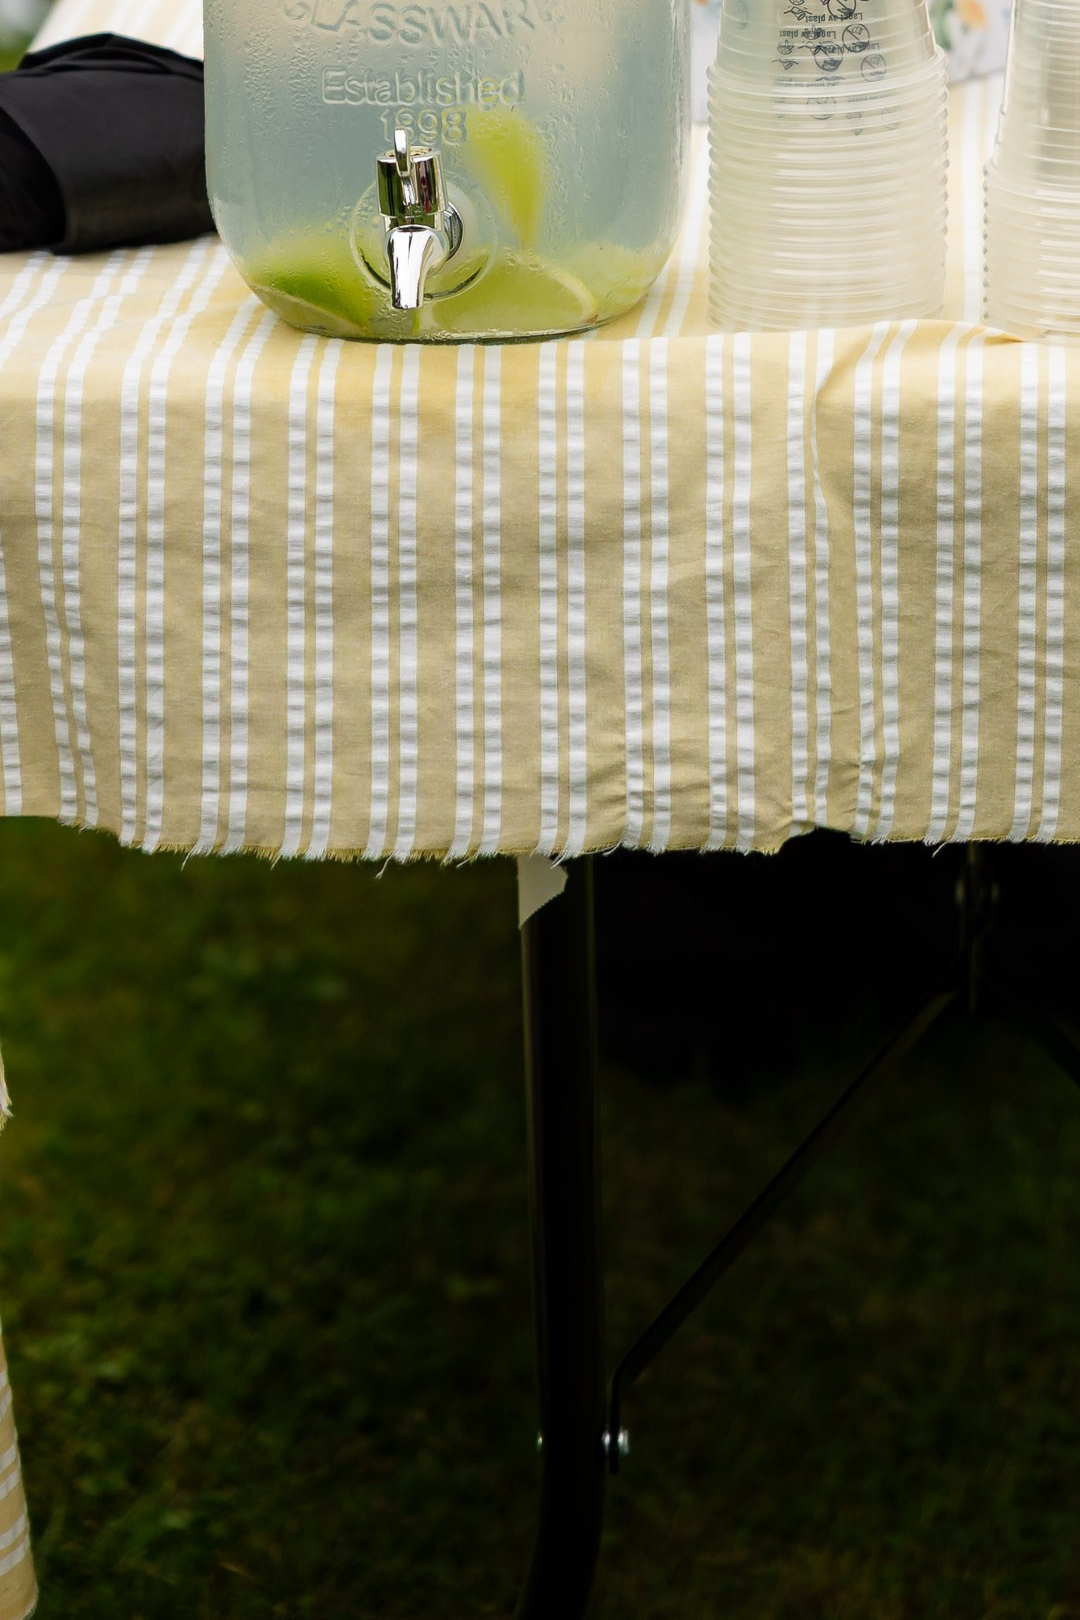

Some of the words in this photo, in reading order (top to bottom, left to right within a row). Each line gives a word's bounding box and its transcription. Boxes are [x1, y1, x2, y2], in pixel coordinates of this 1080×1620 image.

[806, 14, 825, 23] plast
[780, 29, 798, 39] plast
[813, 29, 836, 39] Lagt
[321, 66, 526, 108] Established
[383, 108, 467, 146] 1898
